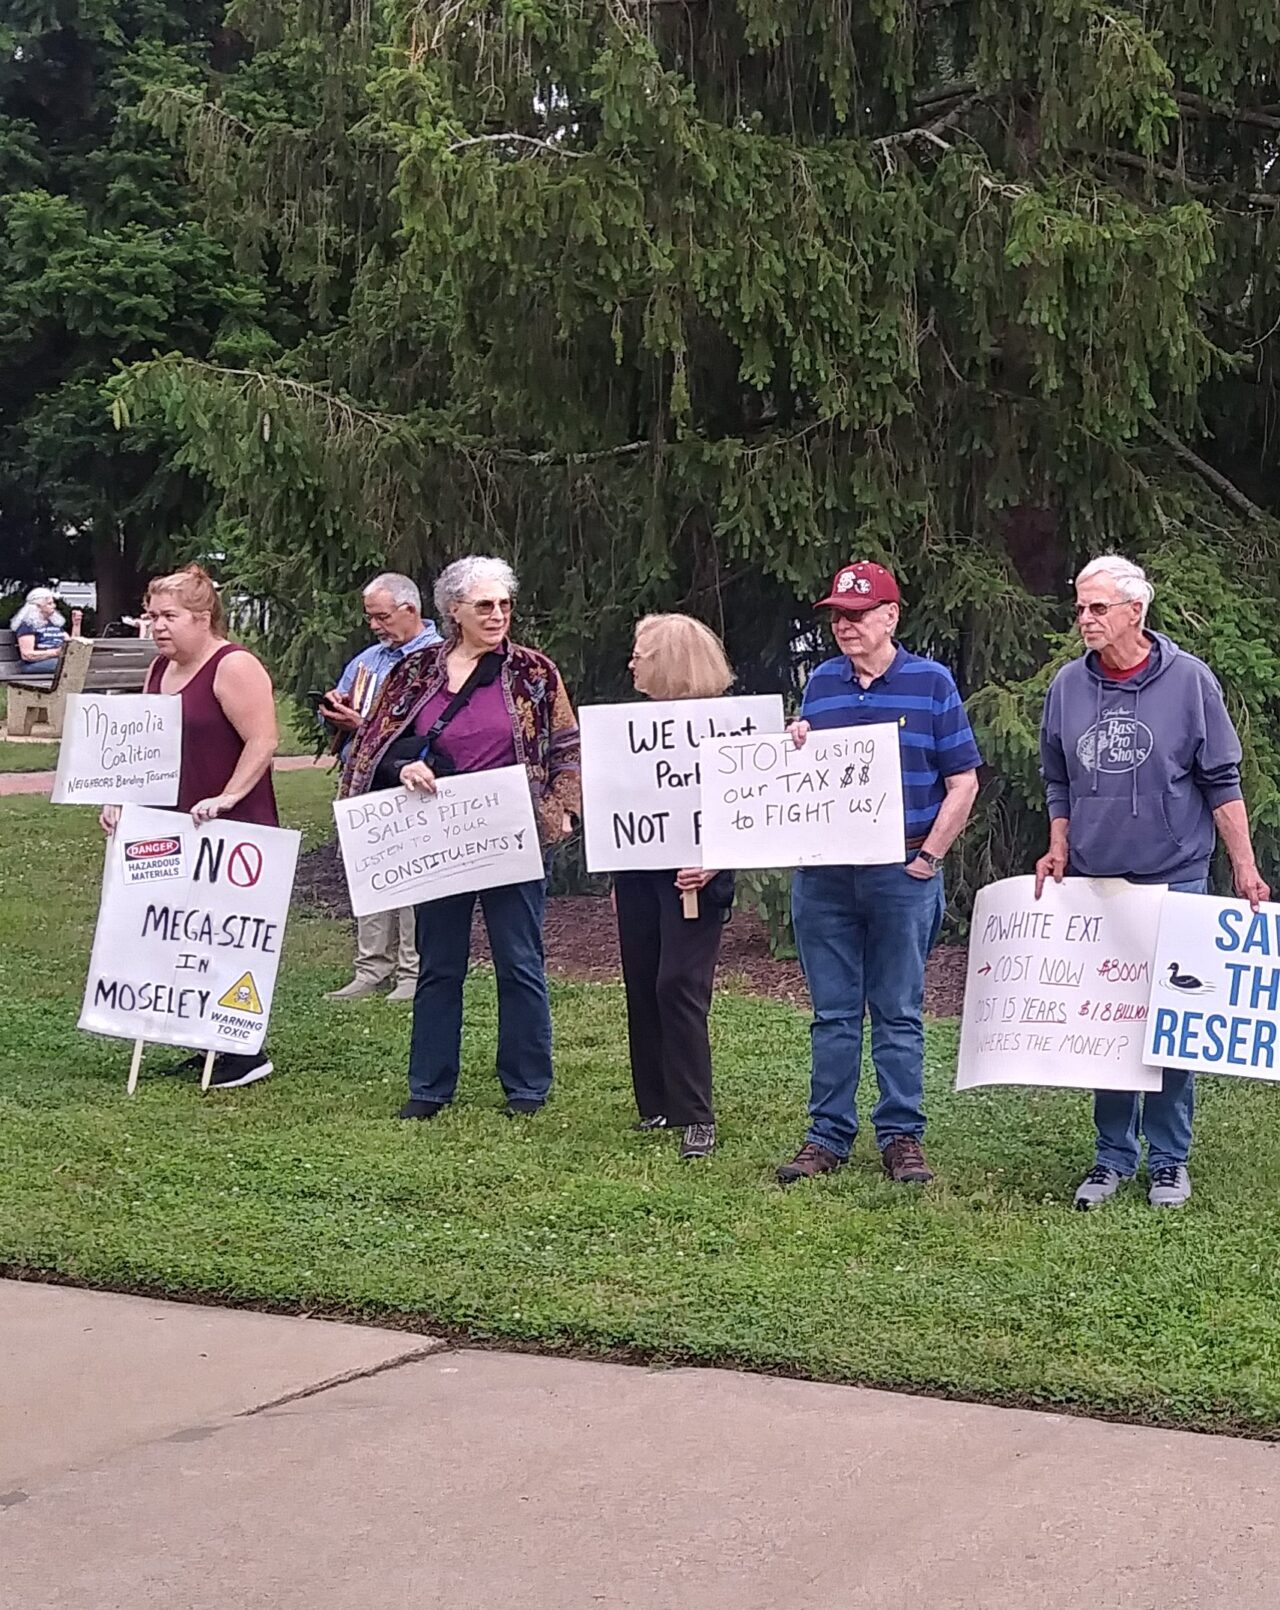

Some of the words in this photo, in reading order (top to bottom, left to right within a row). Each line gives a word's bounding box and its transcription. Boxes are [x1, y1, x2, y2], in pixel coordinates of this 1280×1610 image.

[82, 704, 164, 750] Magnolia
[628, 720, 675, 754] WE
[1108, 720, 1136, 736] Bass
[1109, 735, 1130, 748] Pro
[102, 746, 160, 770] Coalition
[718, 739, 799, 774] STOP
[814, 738, 874, 764] using
[724, 782, 768, 804] our
[776, 768, 830, 794] TAX
[840, 764, 870, 788] $$
[346, 794, 408, 830] DROP
[420, 788, 456, 804] the
[368, 810, 428, 844] SALES
[438, 792, 499, 822] PITCH
[732, 810, 754, 830] to
[766, 800, 836, 827] FIGHT
[850, 792, 887, 824] us!
[355, 842, 404, 873] LISTEN
[410, 834, 431, 848] TO
[442, 817, 488, 838] YOUR
[613, 812, 670, 850] NOT
[128, 858, 180, 871] HAZARDOUS
[131, 842, 174, 855] DANGER
[371, 828, 526, 891] CONSTITUENTS!
[132, 868, 179, 880] MATERIALS
[142, 904, 277, 953] MEGA-SITE
[982, 911, 1054, 944] POWHITE
[1065, 915, 1103, 942] EXT.
[176, 954, 210, 973] IN
[994, 955, 1034, 982] COST
[1039, 957, 1084, 984] NOW
[1096, 958, 1148, 983] $800M
[94, 979, 211, 1018] MOSELEY
[1002, 996, 1016, 1019] 15
[1021, 997, 1067, 1022] YEARS
[210, 1011, 263, 1030] WARNING
[216, 1024, 250, 1039] TOXIC
[1026, 1034, 1054, 1052] THE
[1059, 1034, 1129, 1060] MONEY?
